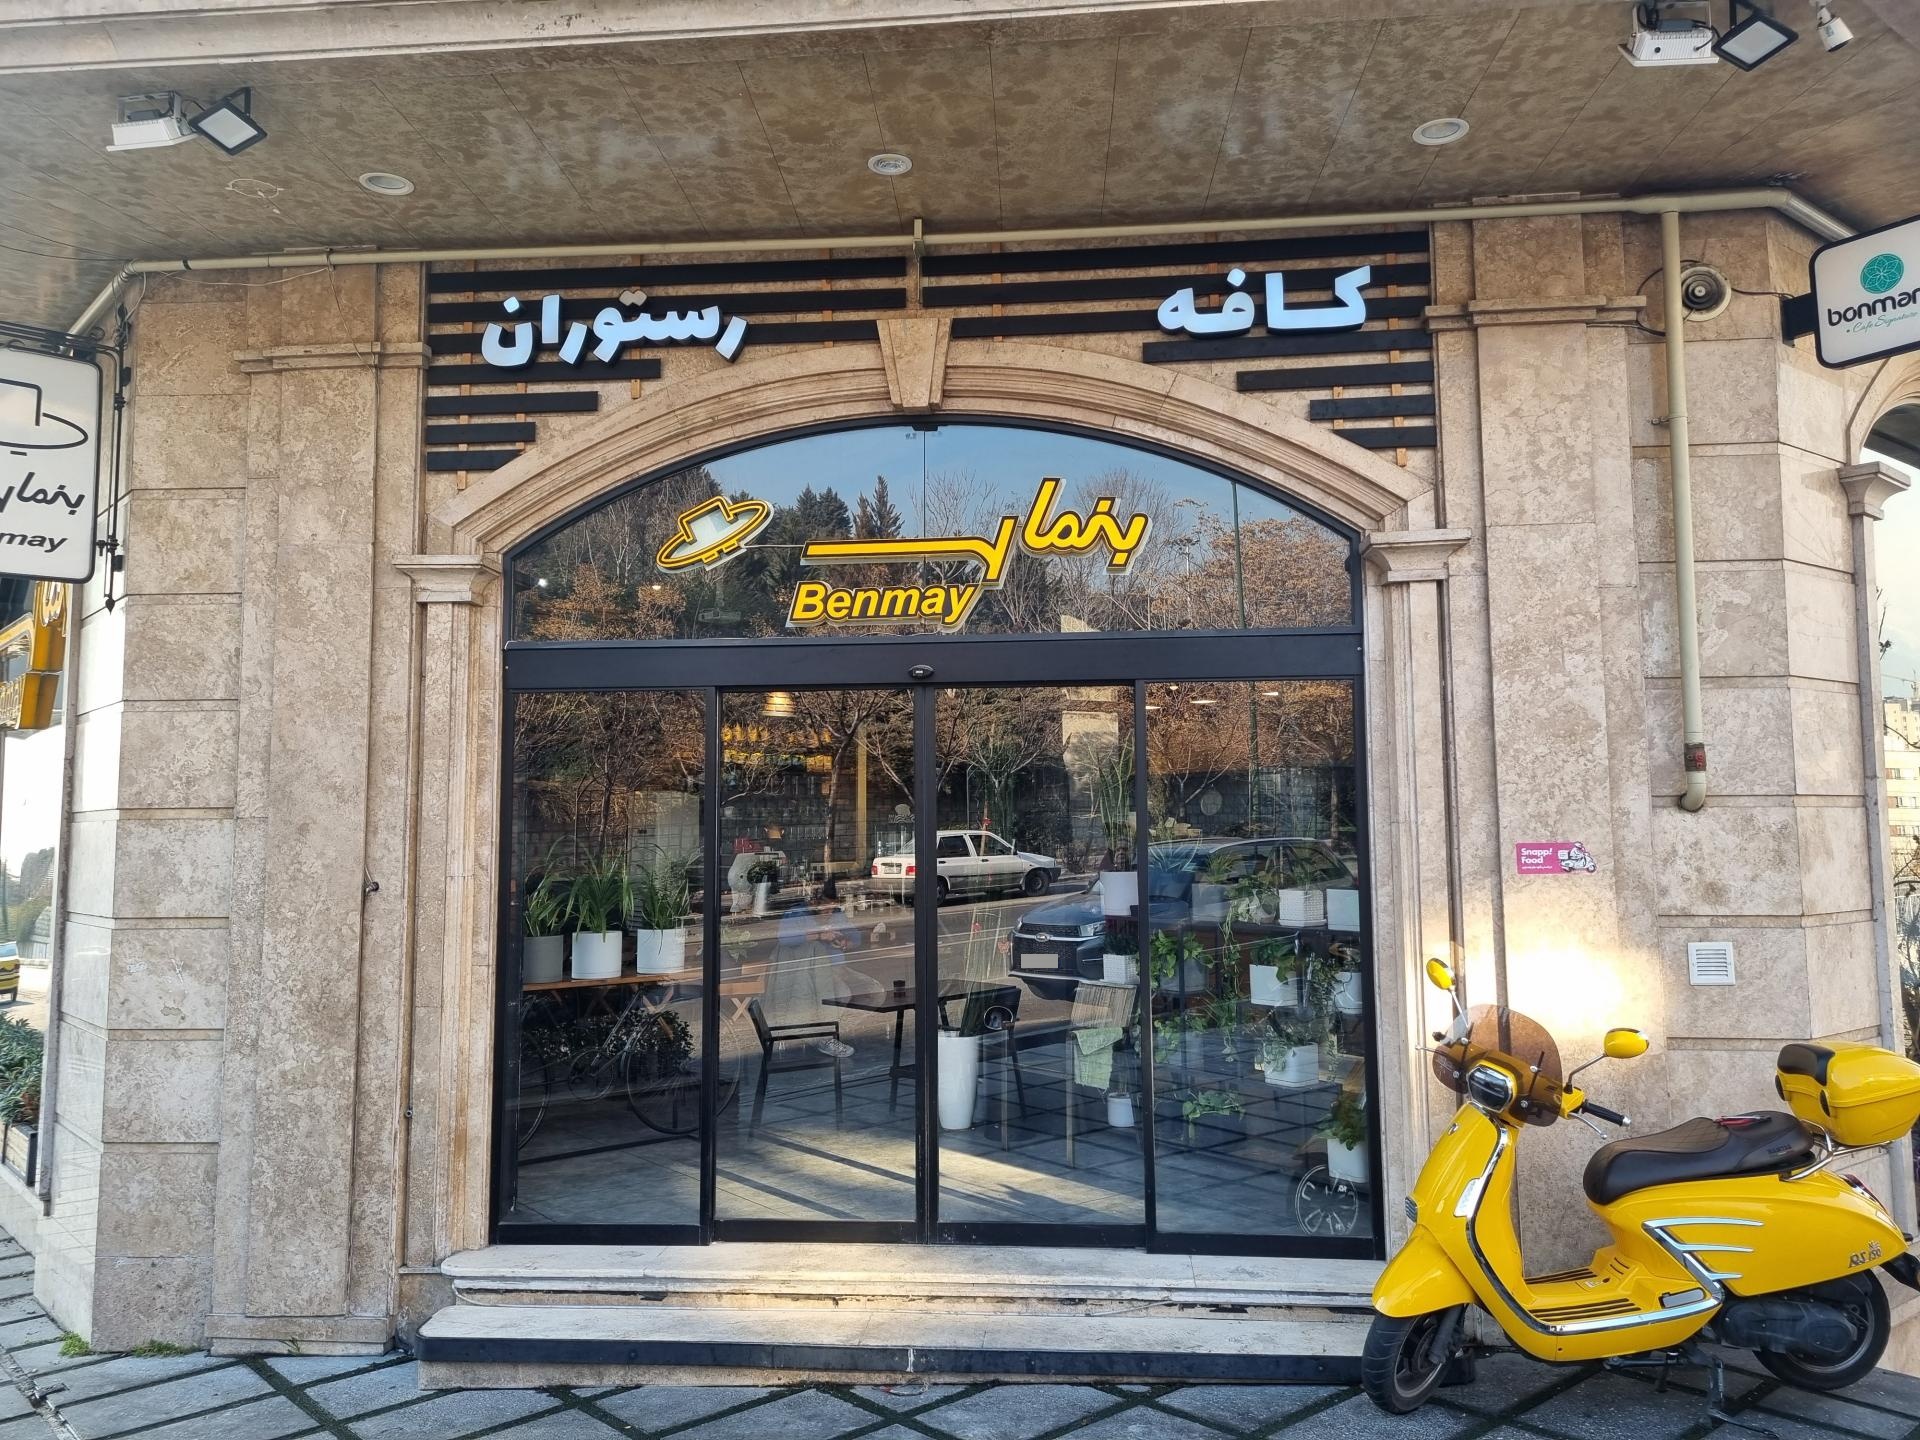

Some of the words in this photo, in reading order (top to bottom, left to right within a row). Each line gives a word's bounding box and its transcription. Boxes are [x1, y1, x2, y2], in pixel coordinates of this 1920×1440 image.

[1157, 265, 1371, 333] کافه
[481, 289, 748, 367] رستوران
[0, 532, 68, 553] may
[789, 582, 976, 627] Benmay
[1521, 847, 1553, 858] Snapp!
[1521, 856, 1543, 864] Food
